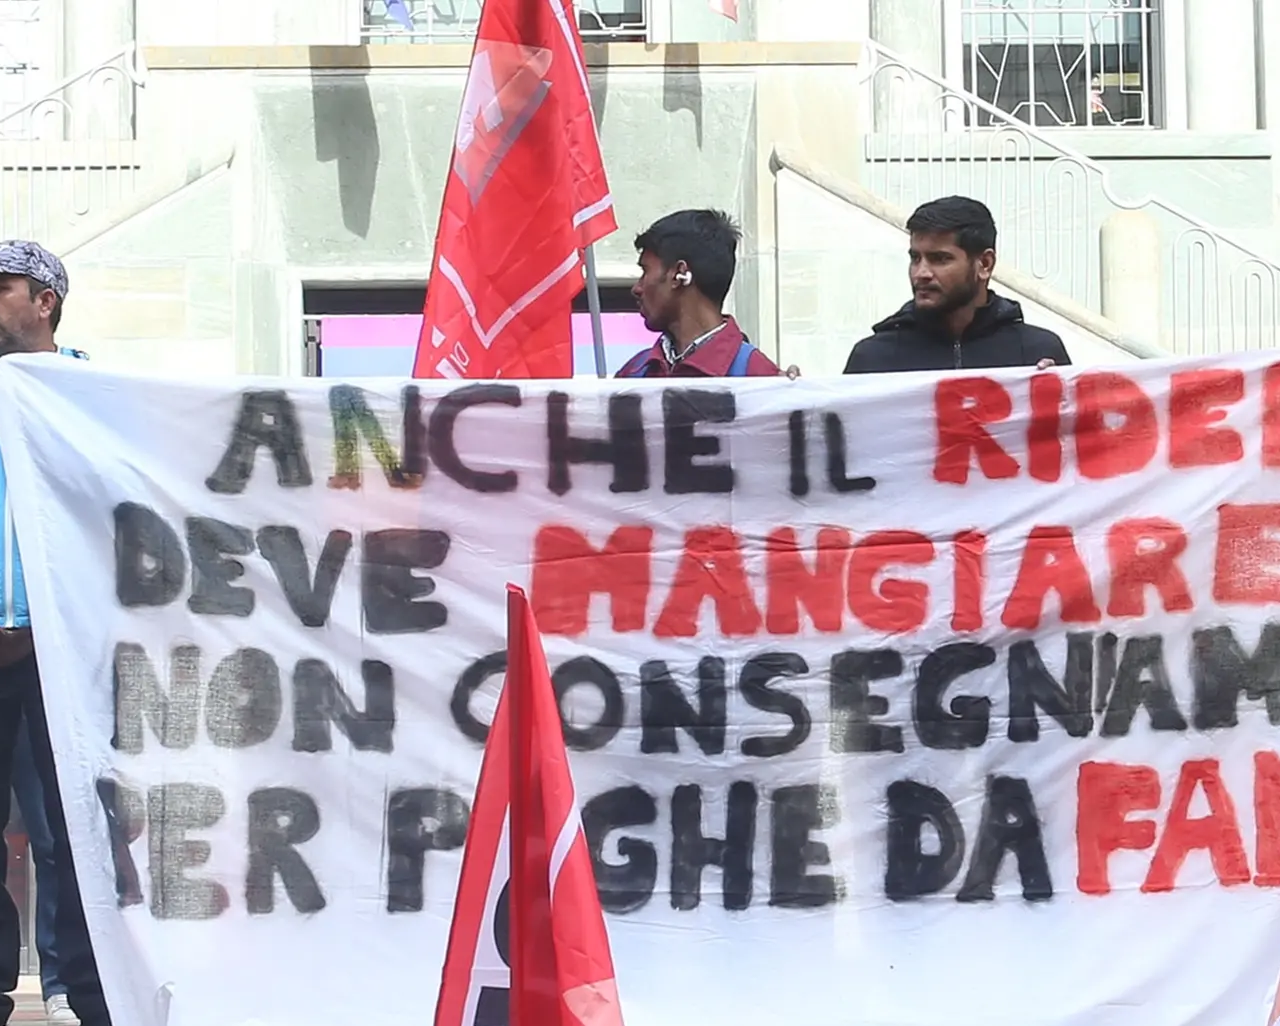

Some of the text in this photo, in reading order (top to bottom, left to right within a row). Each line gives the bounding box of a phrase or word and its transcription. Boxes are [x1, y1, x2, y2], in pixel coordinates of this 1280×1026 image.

[204, 383, 734, 496] ANCHE
[790, 410, 877, 496] IL
[114, 501, 450, 633] DEVE
[113, 642, 394, 753] NON
[385, 780, 846, 915] PGHE
[884, 774, 1053, 902] DA
